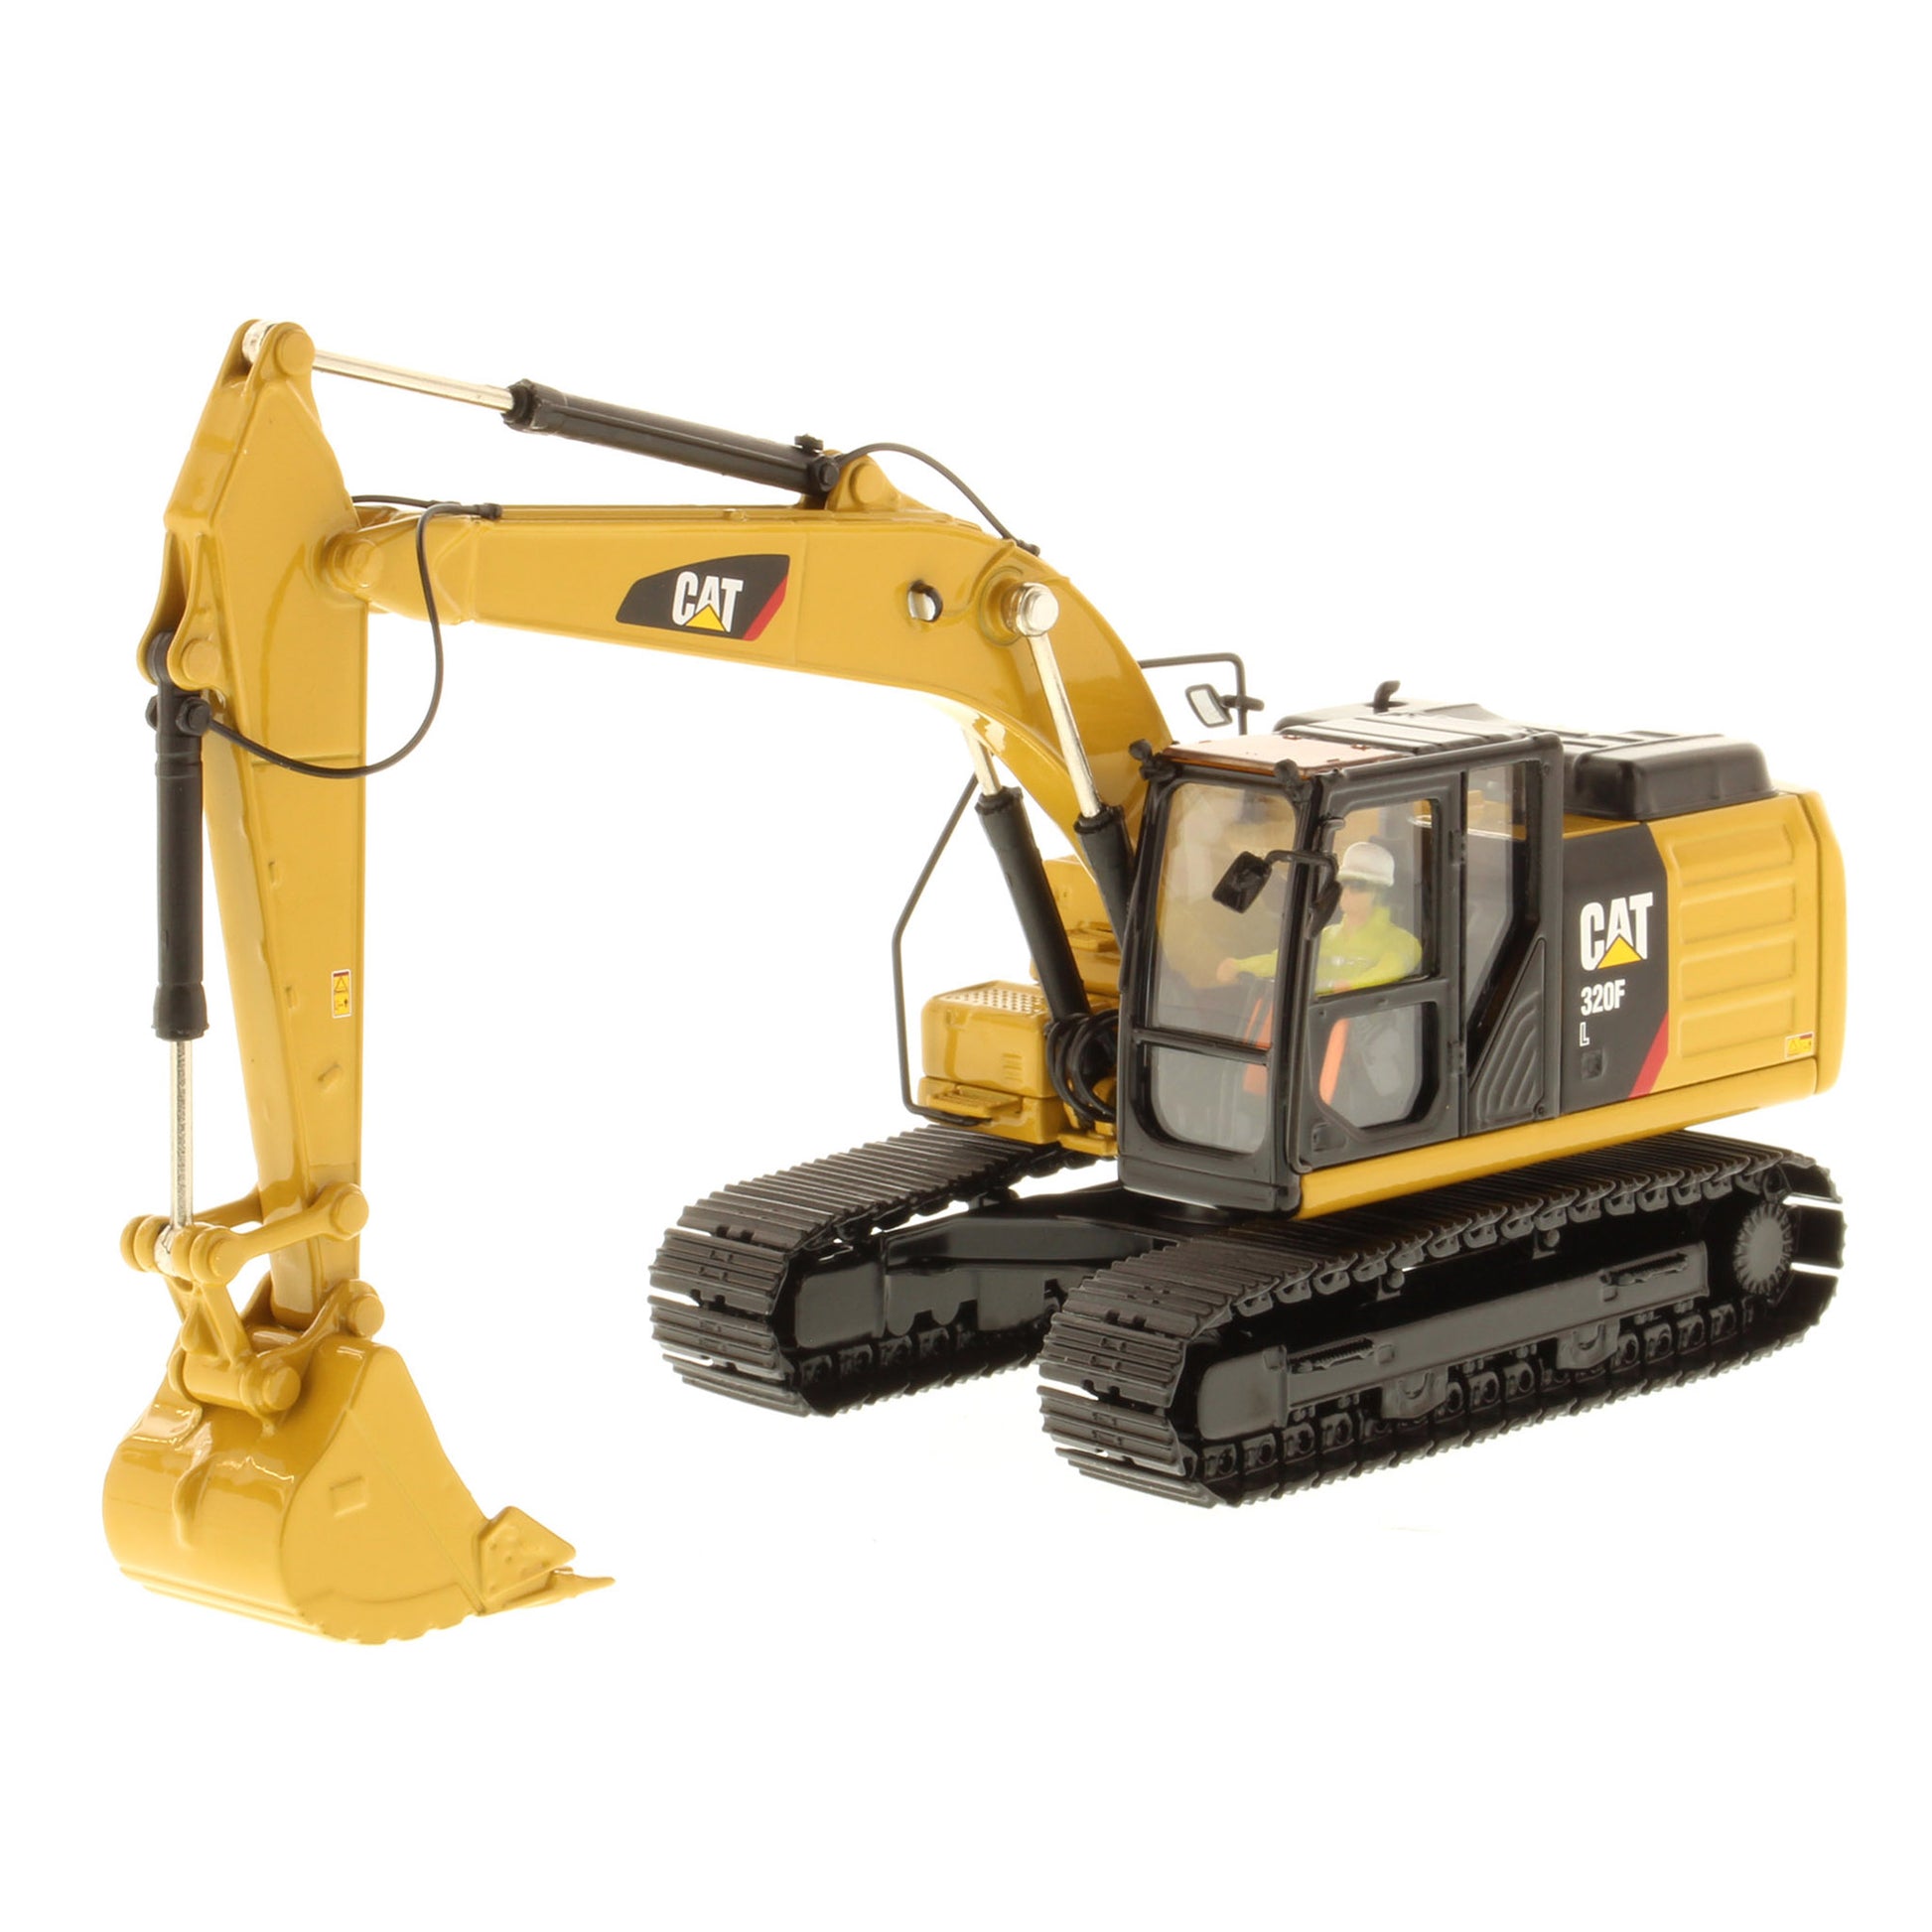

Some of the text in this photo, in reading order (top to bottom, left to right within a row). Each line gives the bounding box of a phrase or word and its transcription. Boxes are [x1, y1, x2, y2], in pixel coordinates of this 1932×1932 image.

[672, 571, 744, 632] CAT
[1581, 892, 1653, 971] CAT
[1581, 979, 1626, 1017] 320F
[1579, 1022, 1590, 1047] L
